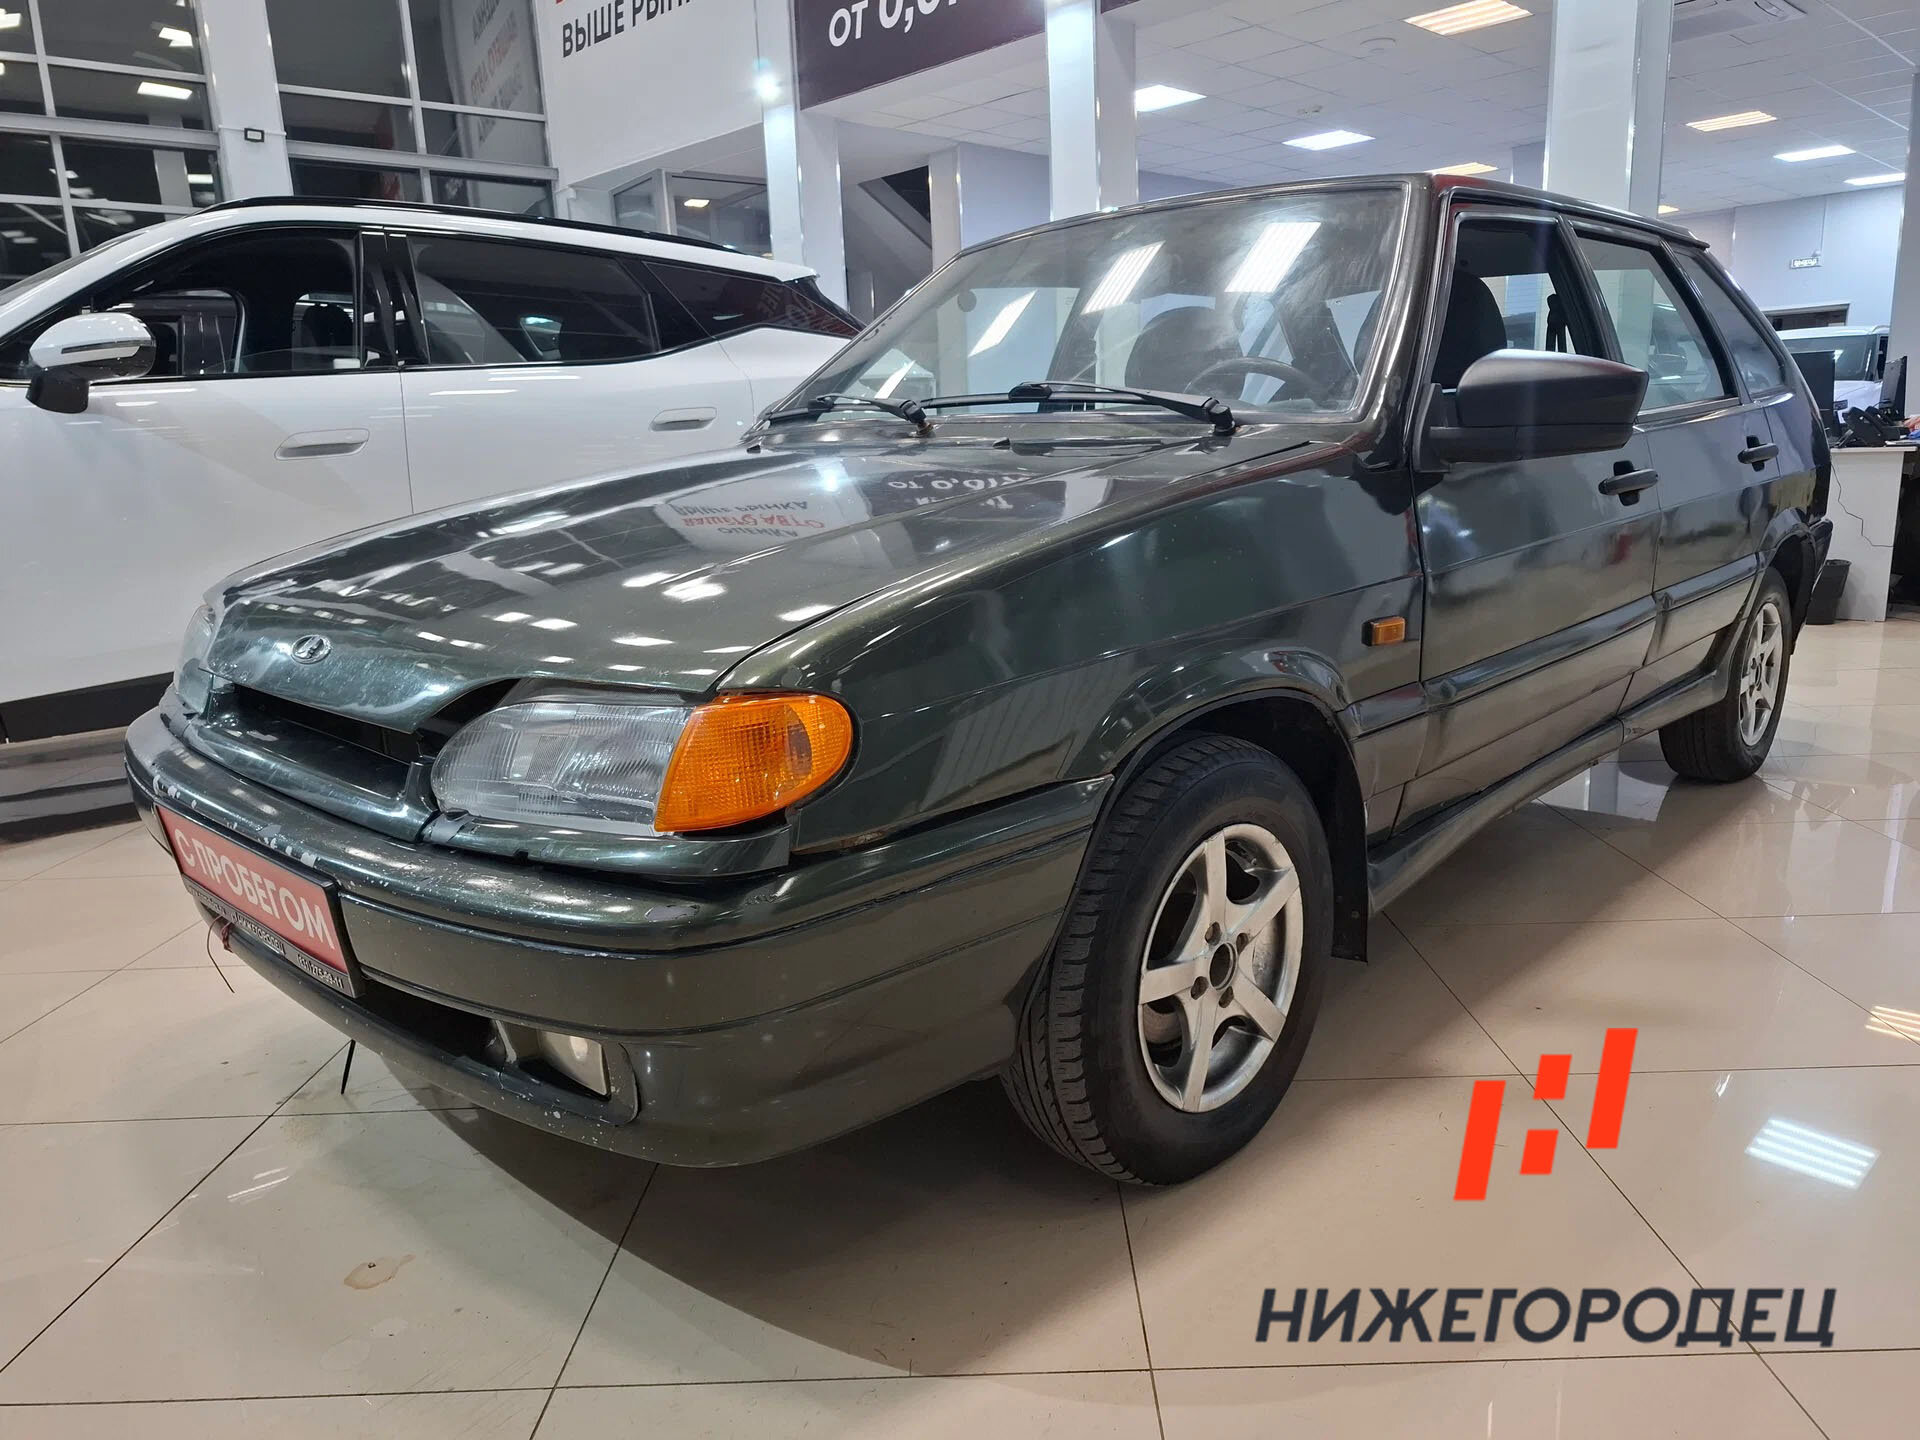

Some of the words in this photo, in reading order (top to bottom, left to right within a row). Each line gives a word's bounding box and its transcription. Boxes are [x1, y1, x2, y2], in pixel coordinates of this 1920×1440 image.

[563, 0, 624, 58] ВЫШЕ
[174, 828, 195, 867] С
[191, 837, 336, 950] ПРОБЕГОМ
